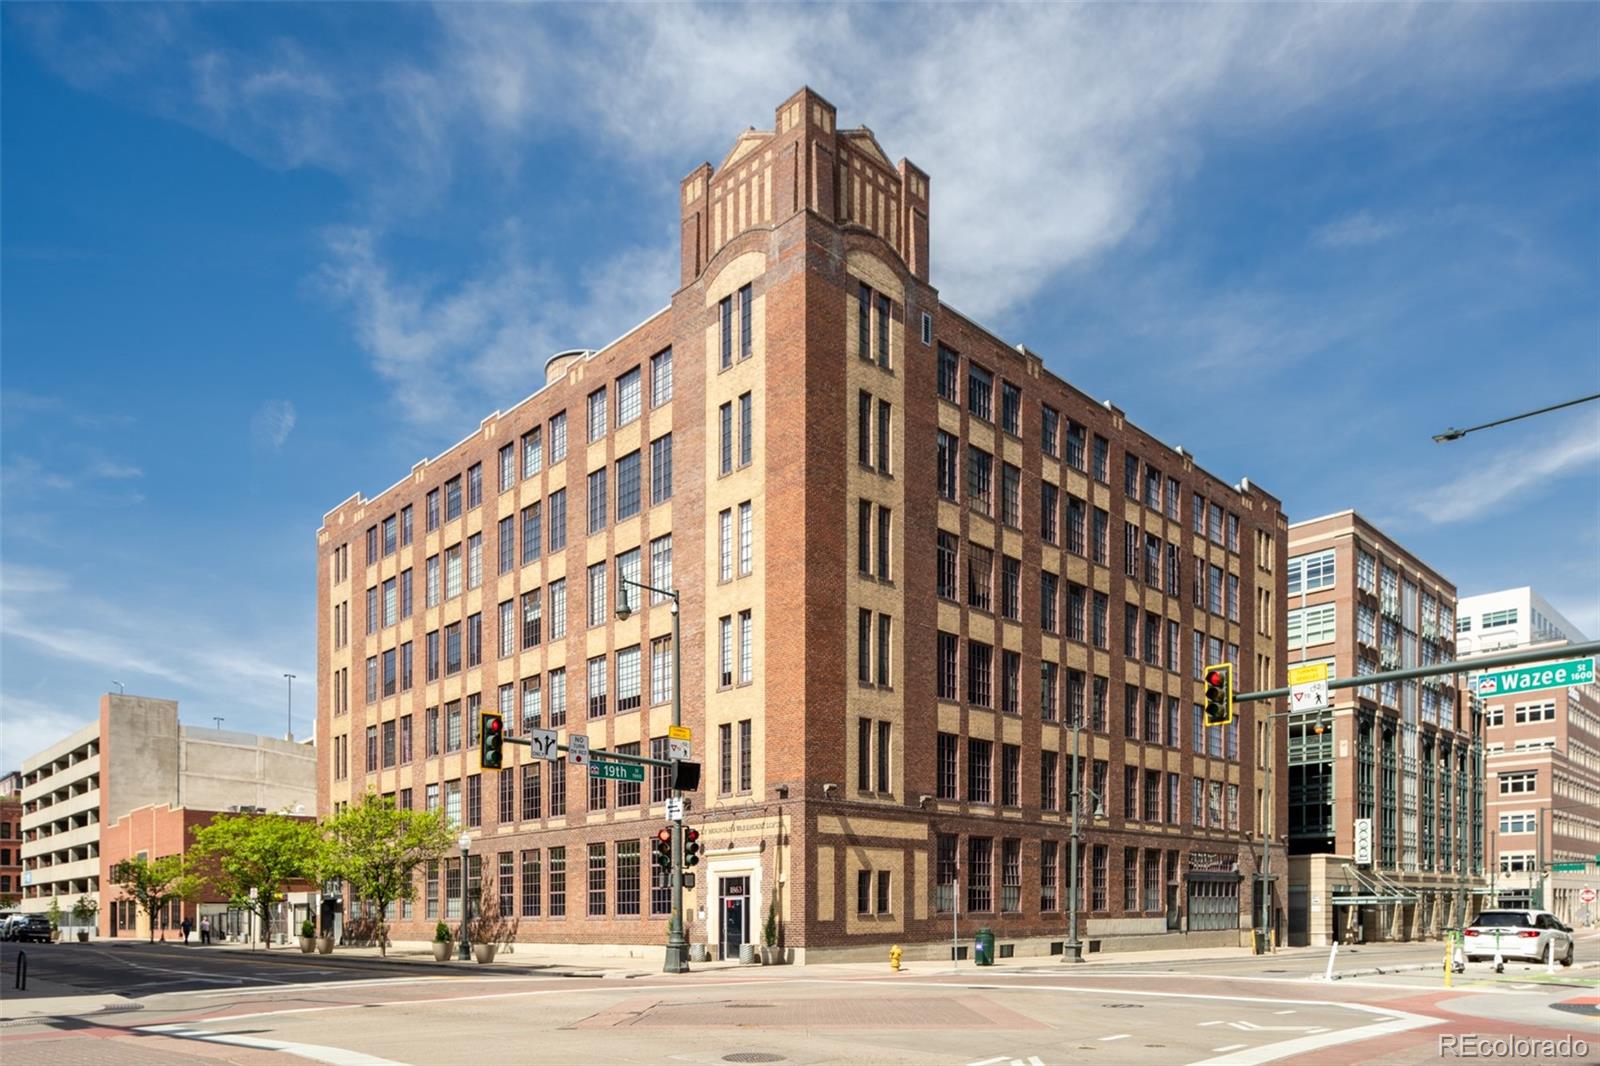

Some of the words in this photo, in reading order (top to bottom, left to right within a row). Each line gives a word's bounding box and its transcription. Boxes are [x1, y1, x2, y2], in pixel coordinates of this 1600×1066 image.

[1577, 663, 1586, 672] St
[1501, 668, 1567, 690] Wazee
[1571, 671, 1592, 681] 1600
[604, 765, 627, 778] 19th
